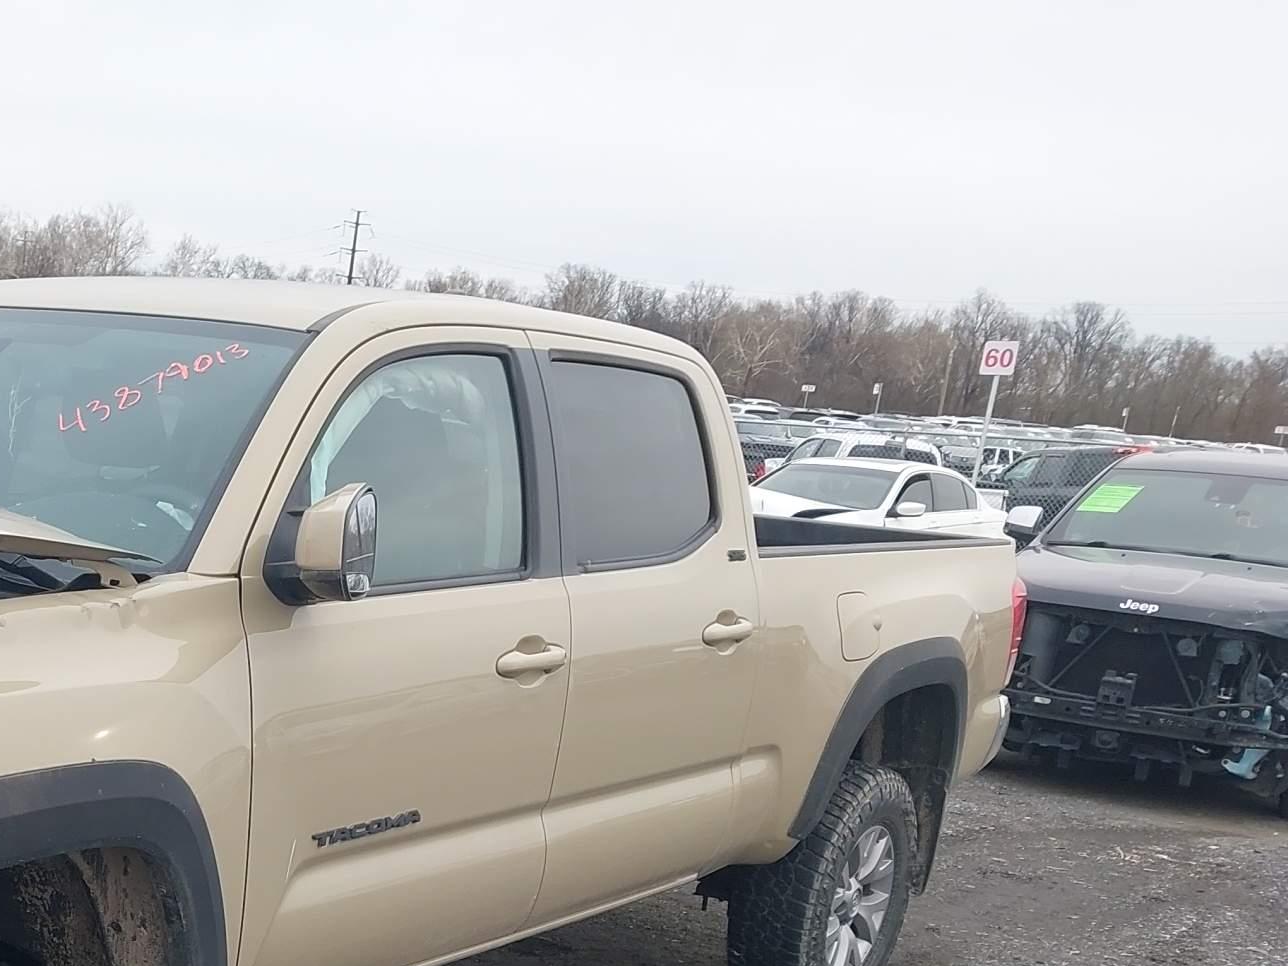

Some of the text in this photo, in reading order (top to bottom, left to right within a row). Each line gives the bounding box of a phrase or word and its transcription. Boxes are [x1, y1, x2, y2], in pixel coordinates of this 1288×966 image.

[984, 349, 1013, 368] 60
[57, 343, 249, 432] 43879013
[1119, 598, 1159, 614] Jeep
[311, 809, 421, 848] TACOMA
